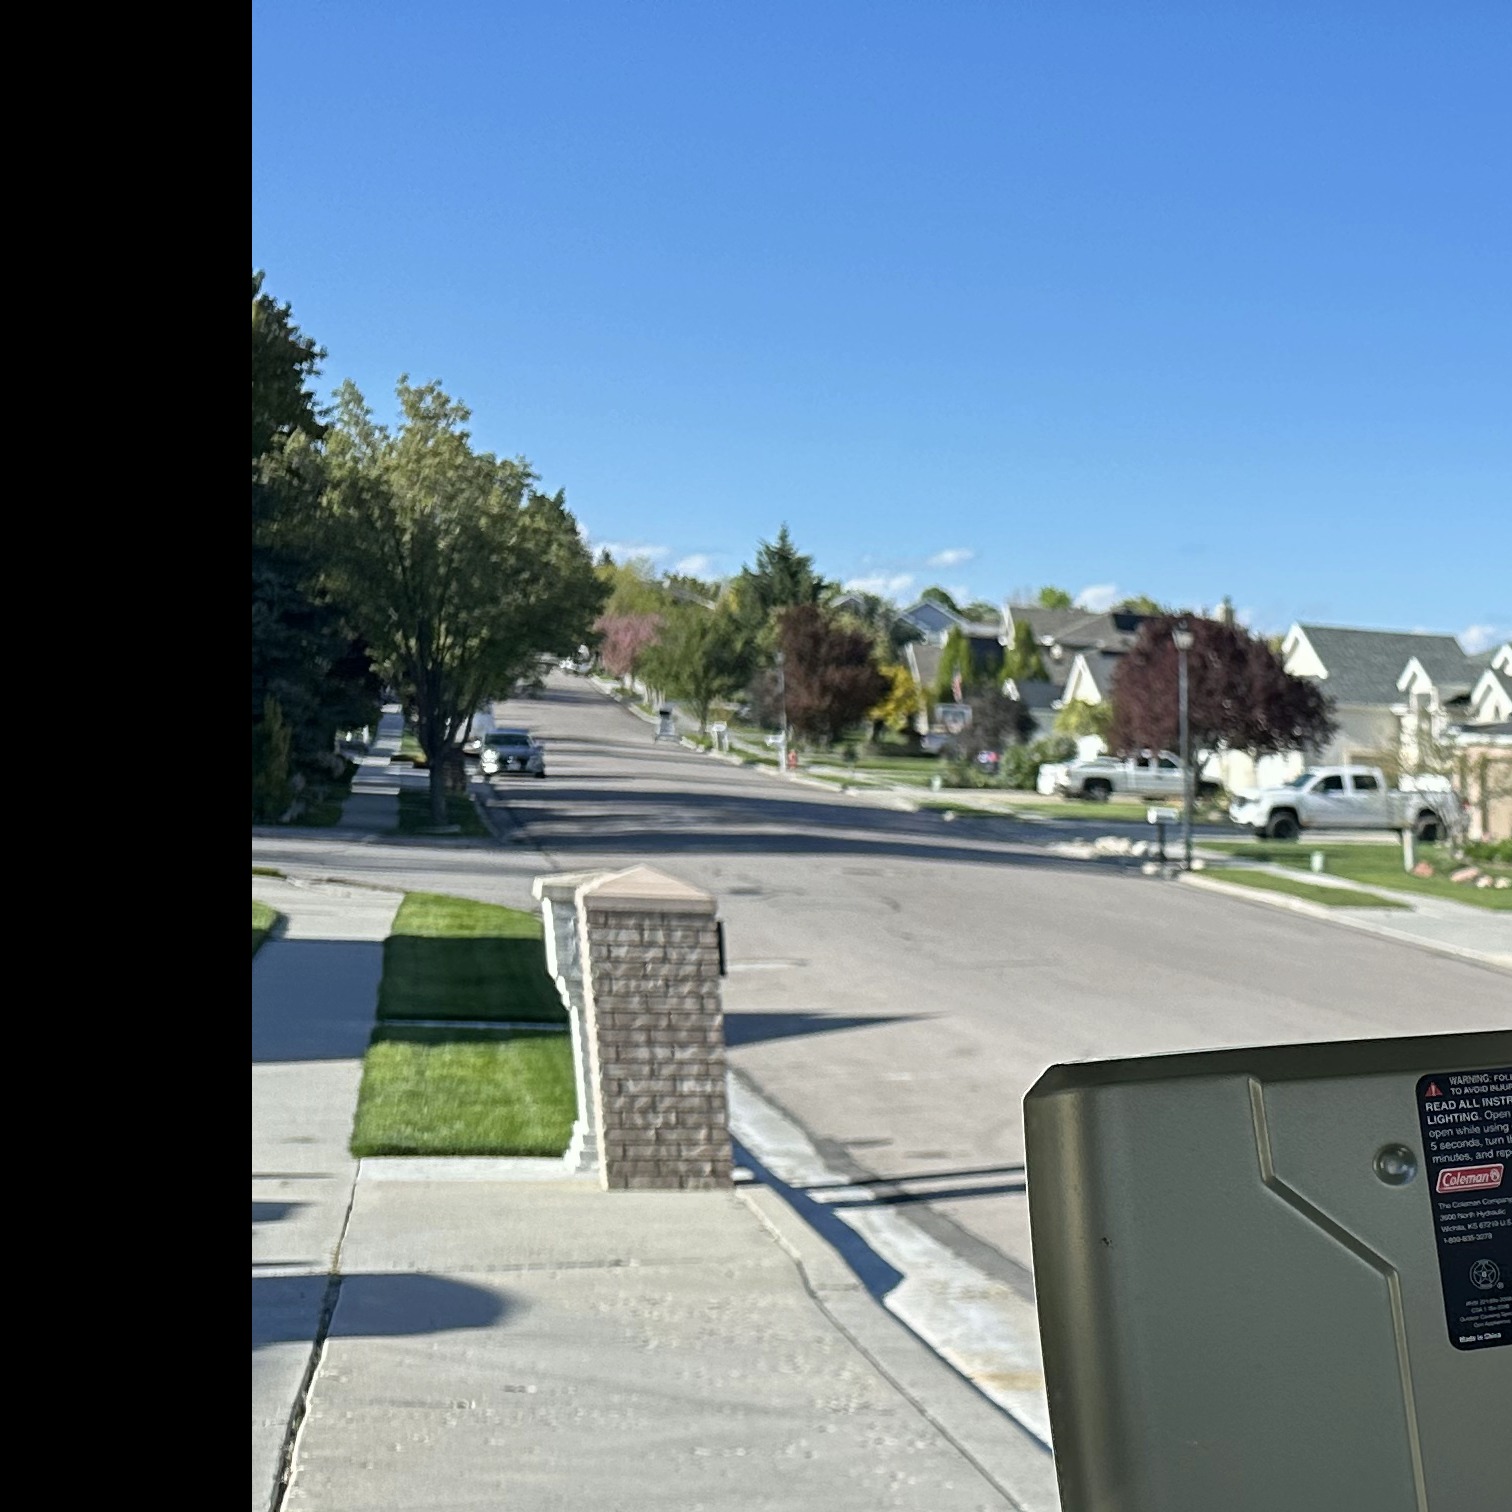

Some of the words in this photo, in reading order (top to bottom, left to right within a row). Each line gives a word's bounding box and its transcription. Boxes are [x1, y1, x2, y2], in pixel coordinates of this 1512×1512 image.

[1425, 1100, 1457, 1112] READ
[1458, 1098, 1480, 1109] ALL
[1427, 1111, 1482, 1125] LIGHTING.
[1442, 1171, 1489, 1187] Coleman
